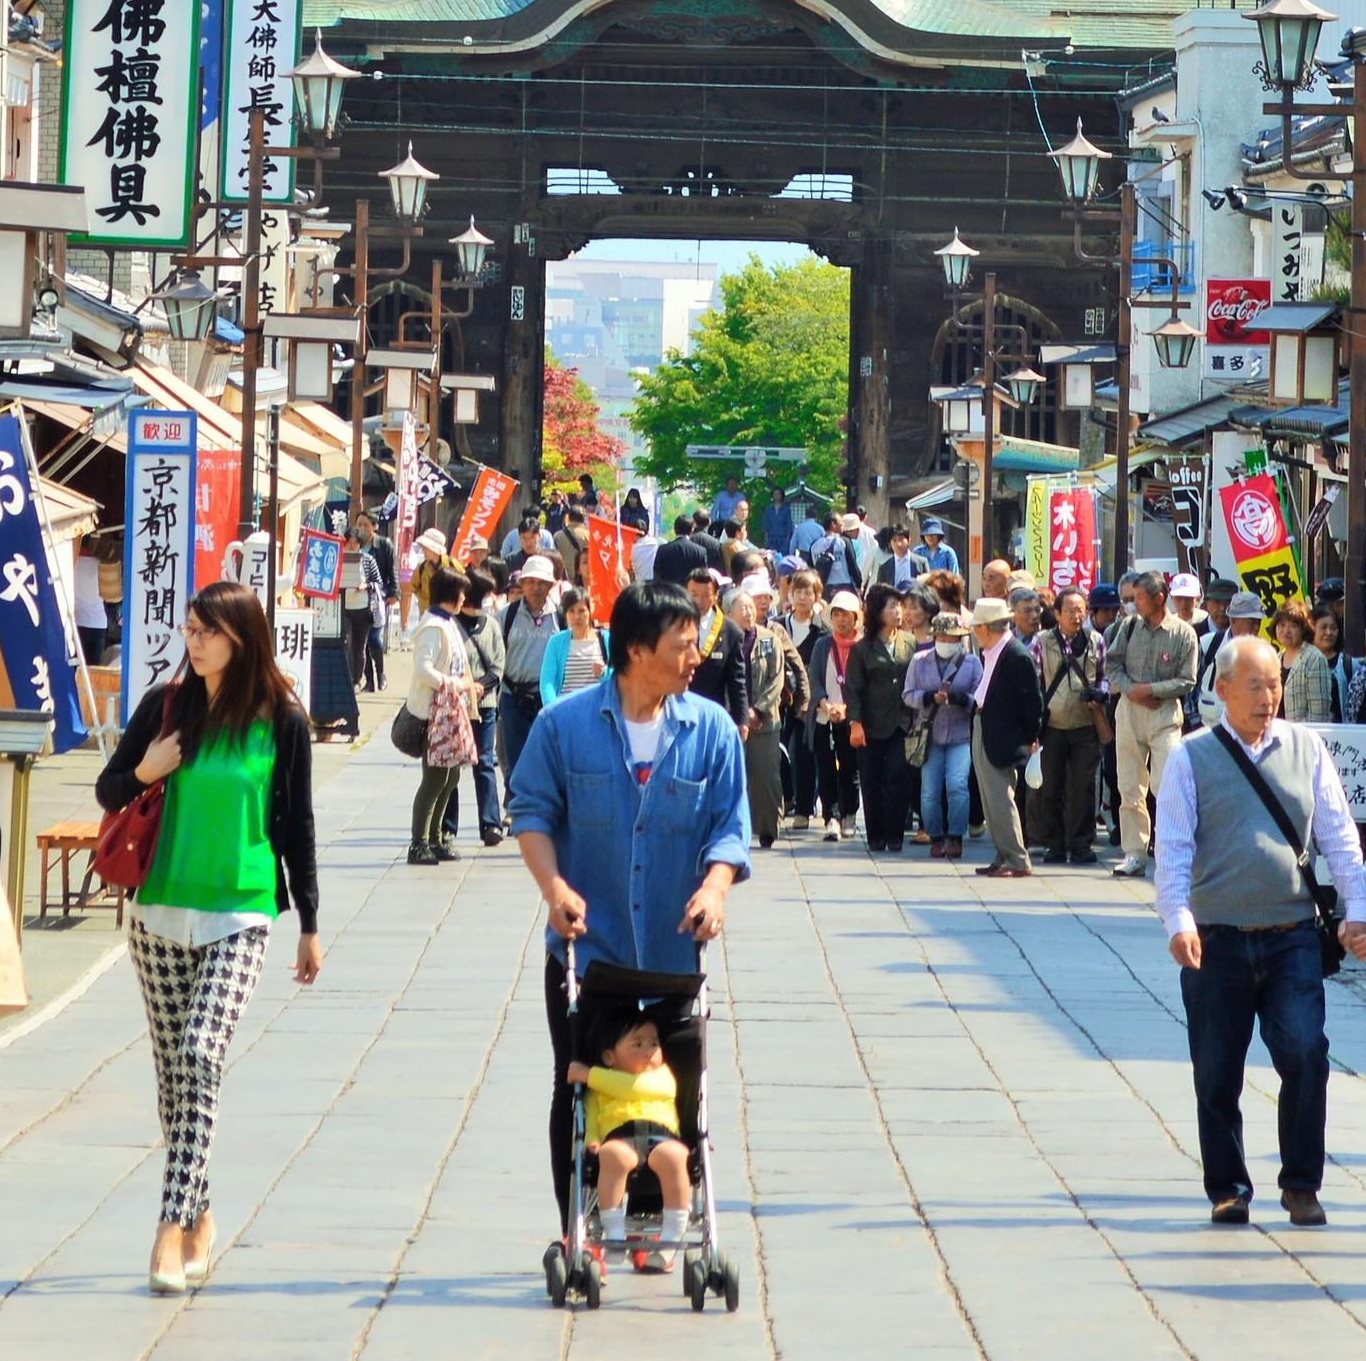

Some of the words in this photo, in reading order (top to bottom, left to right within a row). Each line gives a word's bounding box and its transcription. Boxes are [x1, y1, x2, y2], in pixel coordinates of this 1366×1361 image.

[249, 549, 267, 594] コーヒ
[273, 622, 310, 661] 琲
